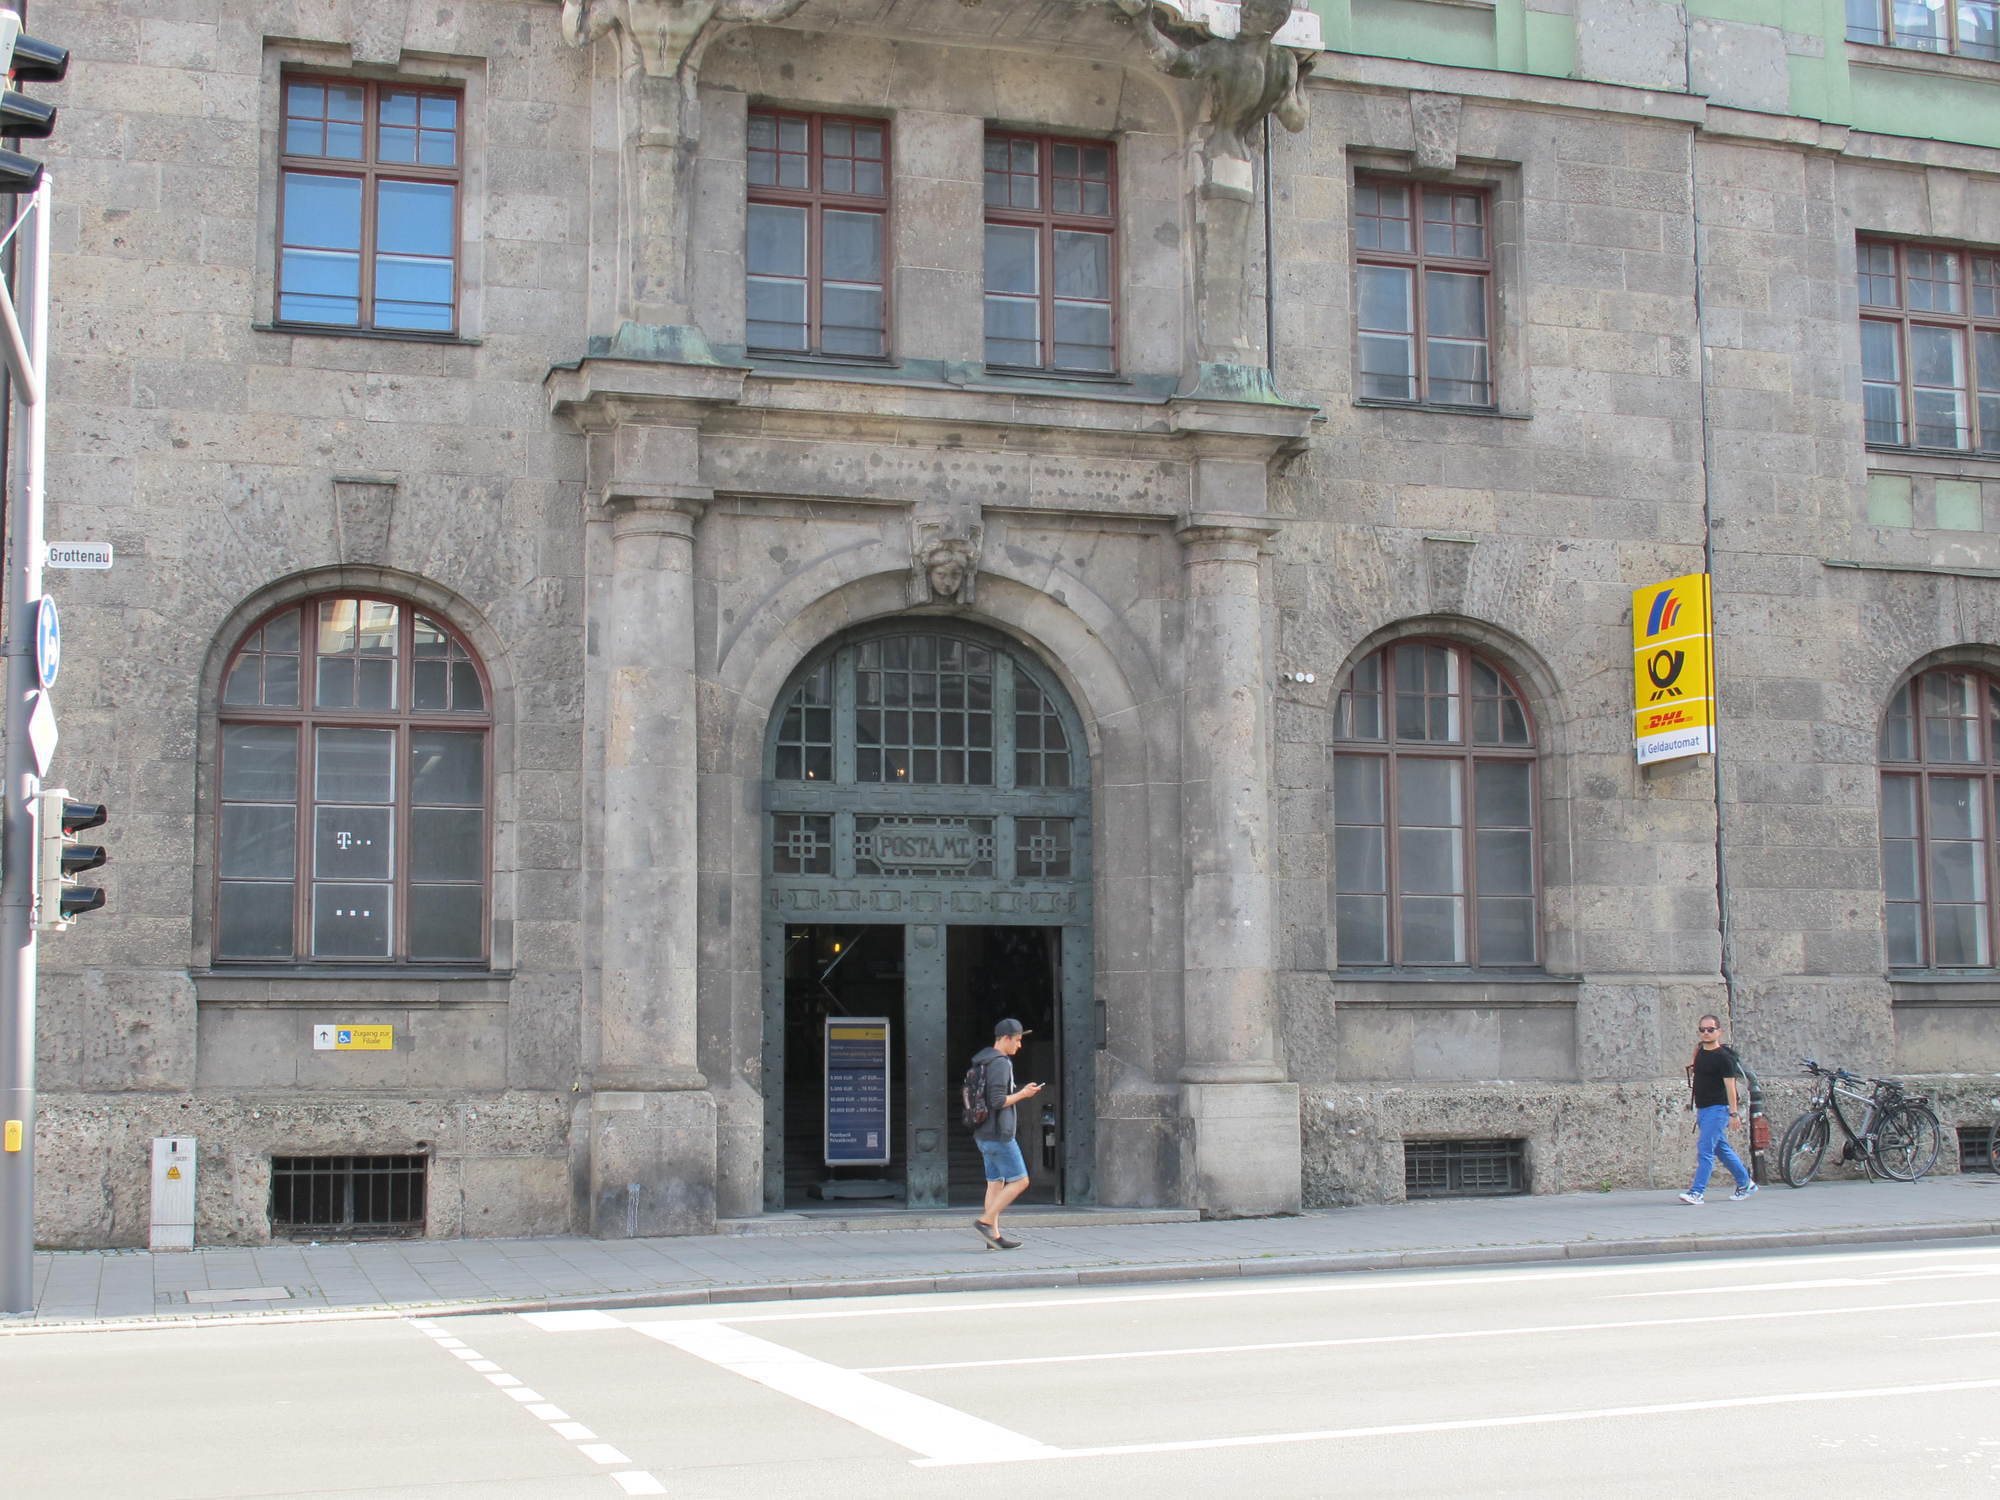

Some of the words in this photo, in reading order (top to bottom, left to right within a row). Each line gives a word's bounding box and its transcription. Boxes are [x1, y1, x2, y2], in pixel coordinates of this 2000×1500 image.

[50, 548, 110, 563] Grottenau
[1649, 710, 1685, 729] DHL
[1647, 736, 1700, 754] Geldautomat
[879, 836, 972, 859] POSTAMT
[353, 1030, 378, 1038] Zugang
